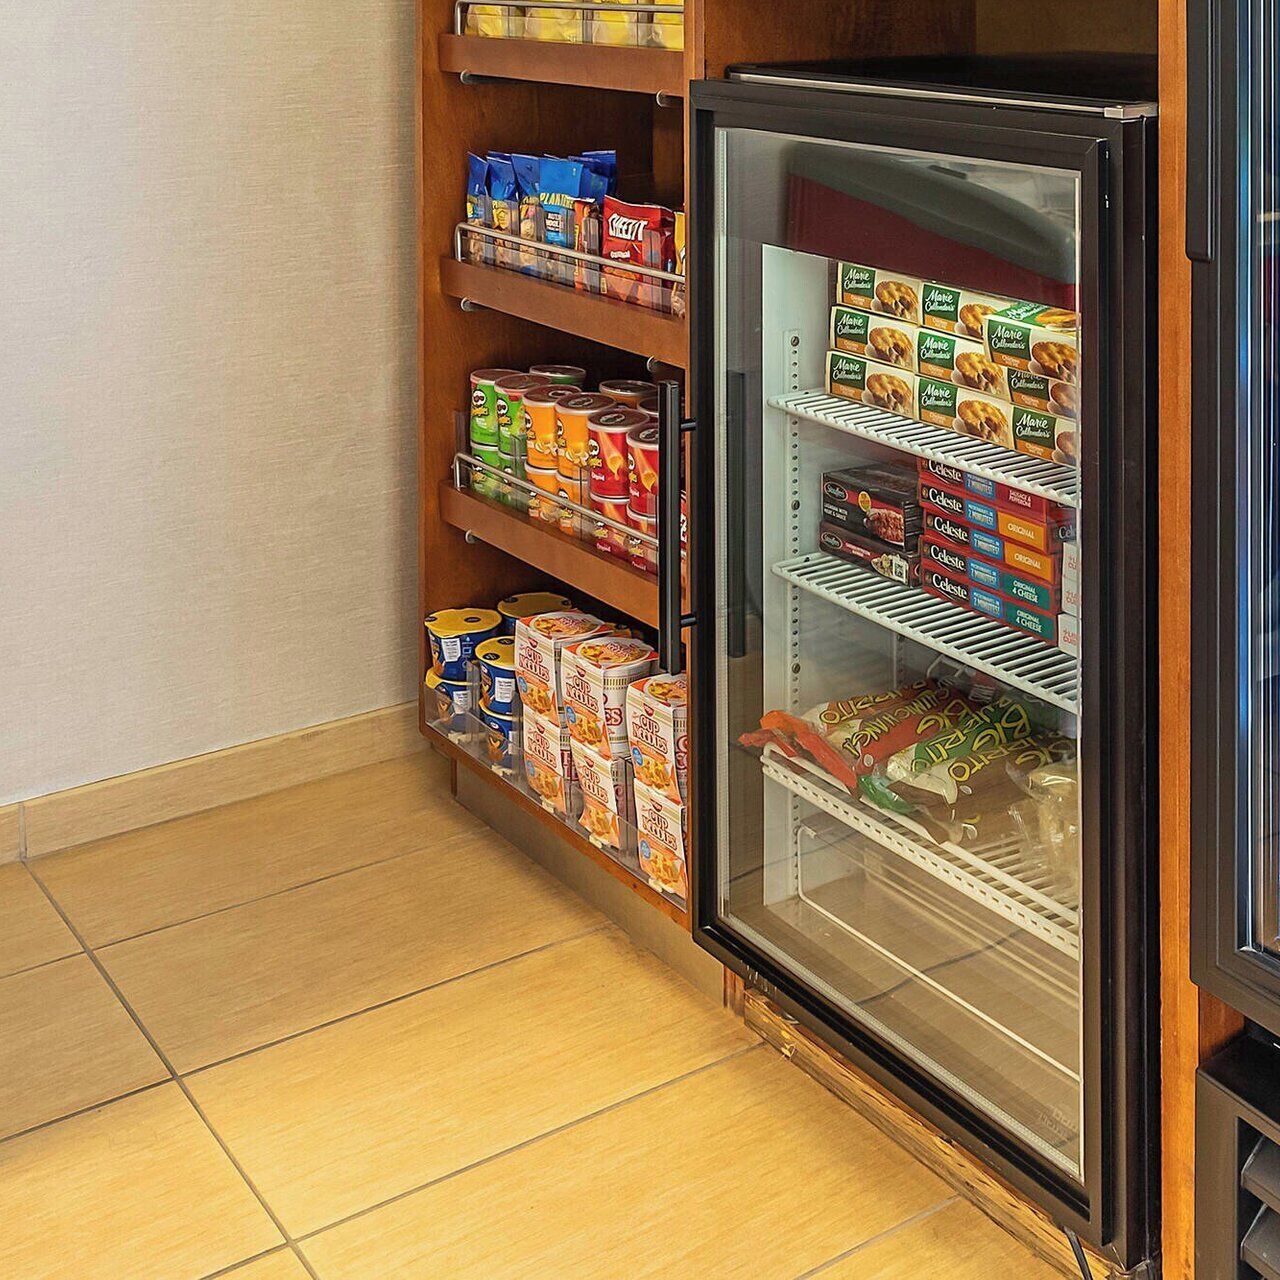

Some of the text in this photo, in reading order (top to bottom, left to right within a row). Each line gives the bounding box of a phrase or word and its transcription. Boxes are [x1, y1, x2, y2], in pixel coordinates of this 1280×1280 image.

[845, 269, 870, 281] Marie
[925, 290, 953, 305] Marie
[838, 314, 863, 327] Marie
[991, 327, 1023, 341] Marie
[921, 337, 949, 352] Marie
[833, 359, 860, 372] Marie
[922, 383, 951, 398] Marie
[1016, 415, 1048, 428] Marie
[928, 459, 962, 481] Celeste
[929, 488, 963, 511] Celeste
[934, 518, 969, 542] Celeste
[1008, 523, 1035, 540] ORIGINAL
[931, 545, 965, 569] Celeste
[1014, 553, 1041, 569] ORIGINAL
[933, 574, 968, 599] Celeste
[1013, 580, 1036, 593] ORIGINAL
[1018, 588, 1039, 603] CHEESE
[1017, 610, 1039, 624] ORIGINAL
[1021, 618, 1042, 633] CHEESE
[526, 646, 543, 664] CUP
[519, 653, 550, 682] NOODLES
[573, 675, 591, 694] CUP
[566, 682, 599, 713] NOODLES
[640, 713, 660, 733] CUP
[536, 733, 550, 749] CUP
[633, 721, 668, 754] NOODLES
[528, 737, 557, 768] NOODLES
[583, 766, 600, 784] CUP
[649, 809, 669, 829] CUP
[642, 815, 677, 850] NOODLES
